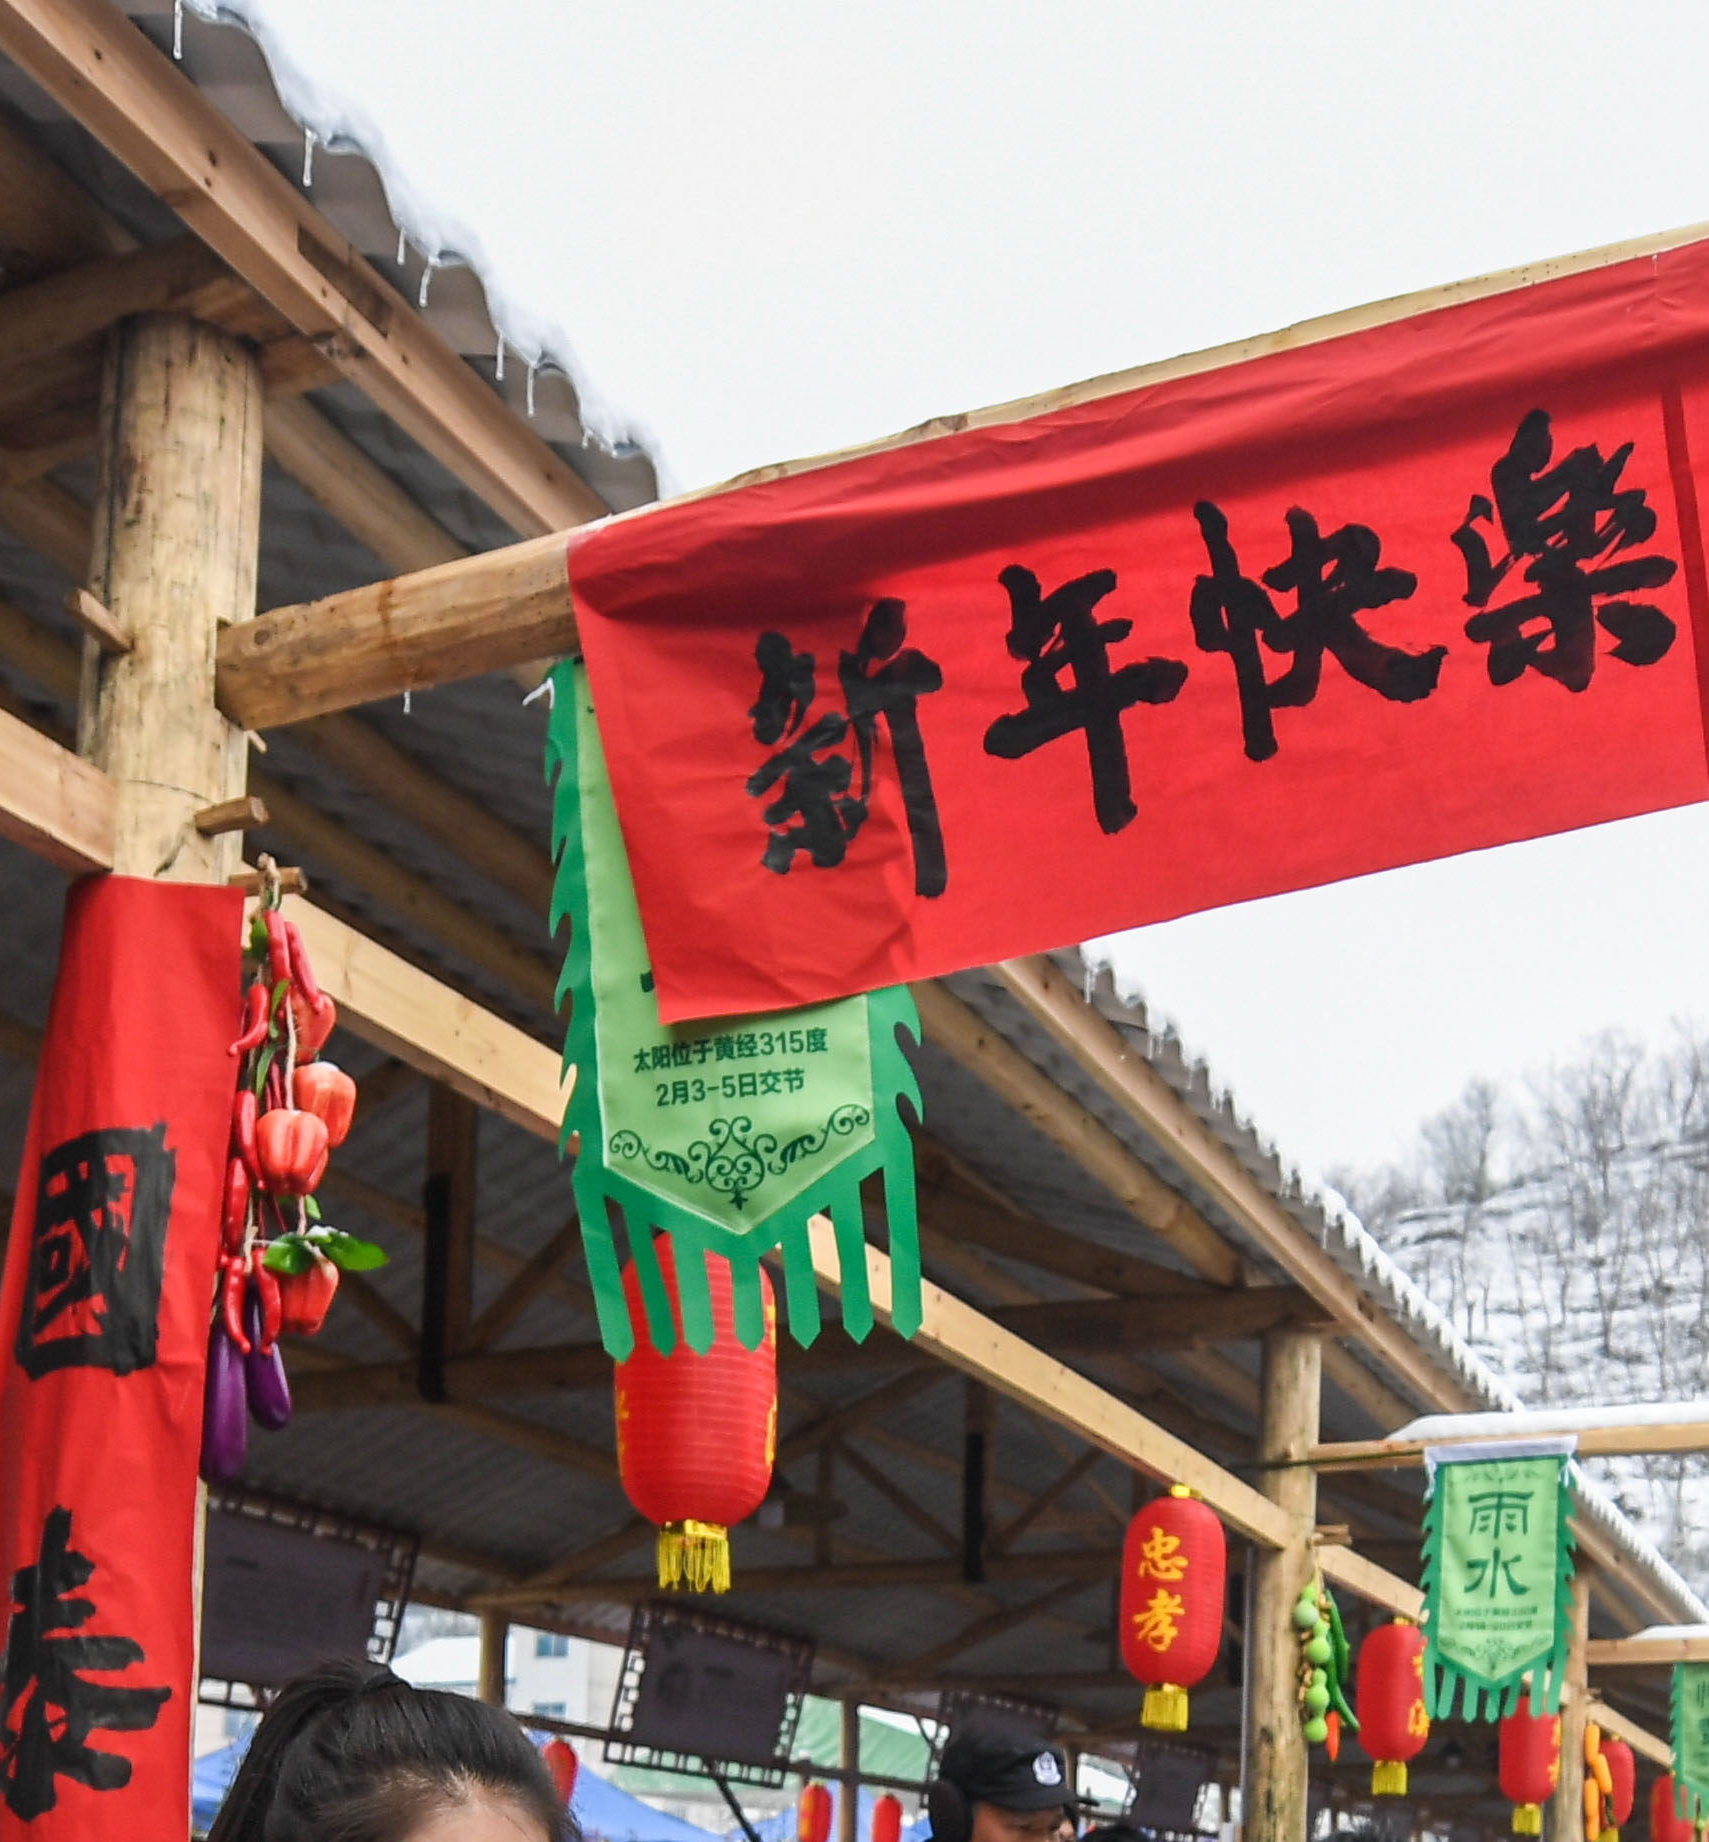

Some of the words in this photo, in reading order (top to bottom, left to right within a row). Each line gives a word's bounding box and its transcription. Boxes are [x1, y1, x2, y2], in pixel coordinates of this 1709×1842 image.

[633, 1027, 828, 1074] 太阳位于黄经315度
[656, 1068, 805, 1107] 2月3-5日交节
[1463, 1491, 1534, 1598] 雨水
[1133, 1526, 1188, 1652] 忠孝
